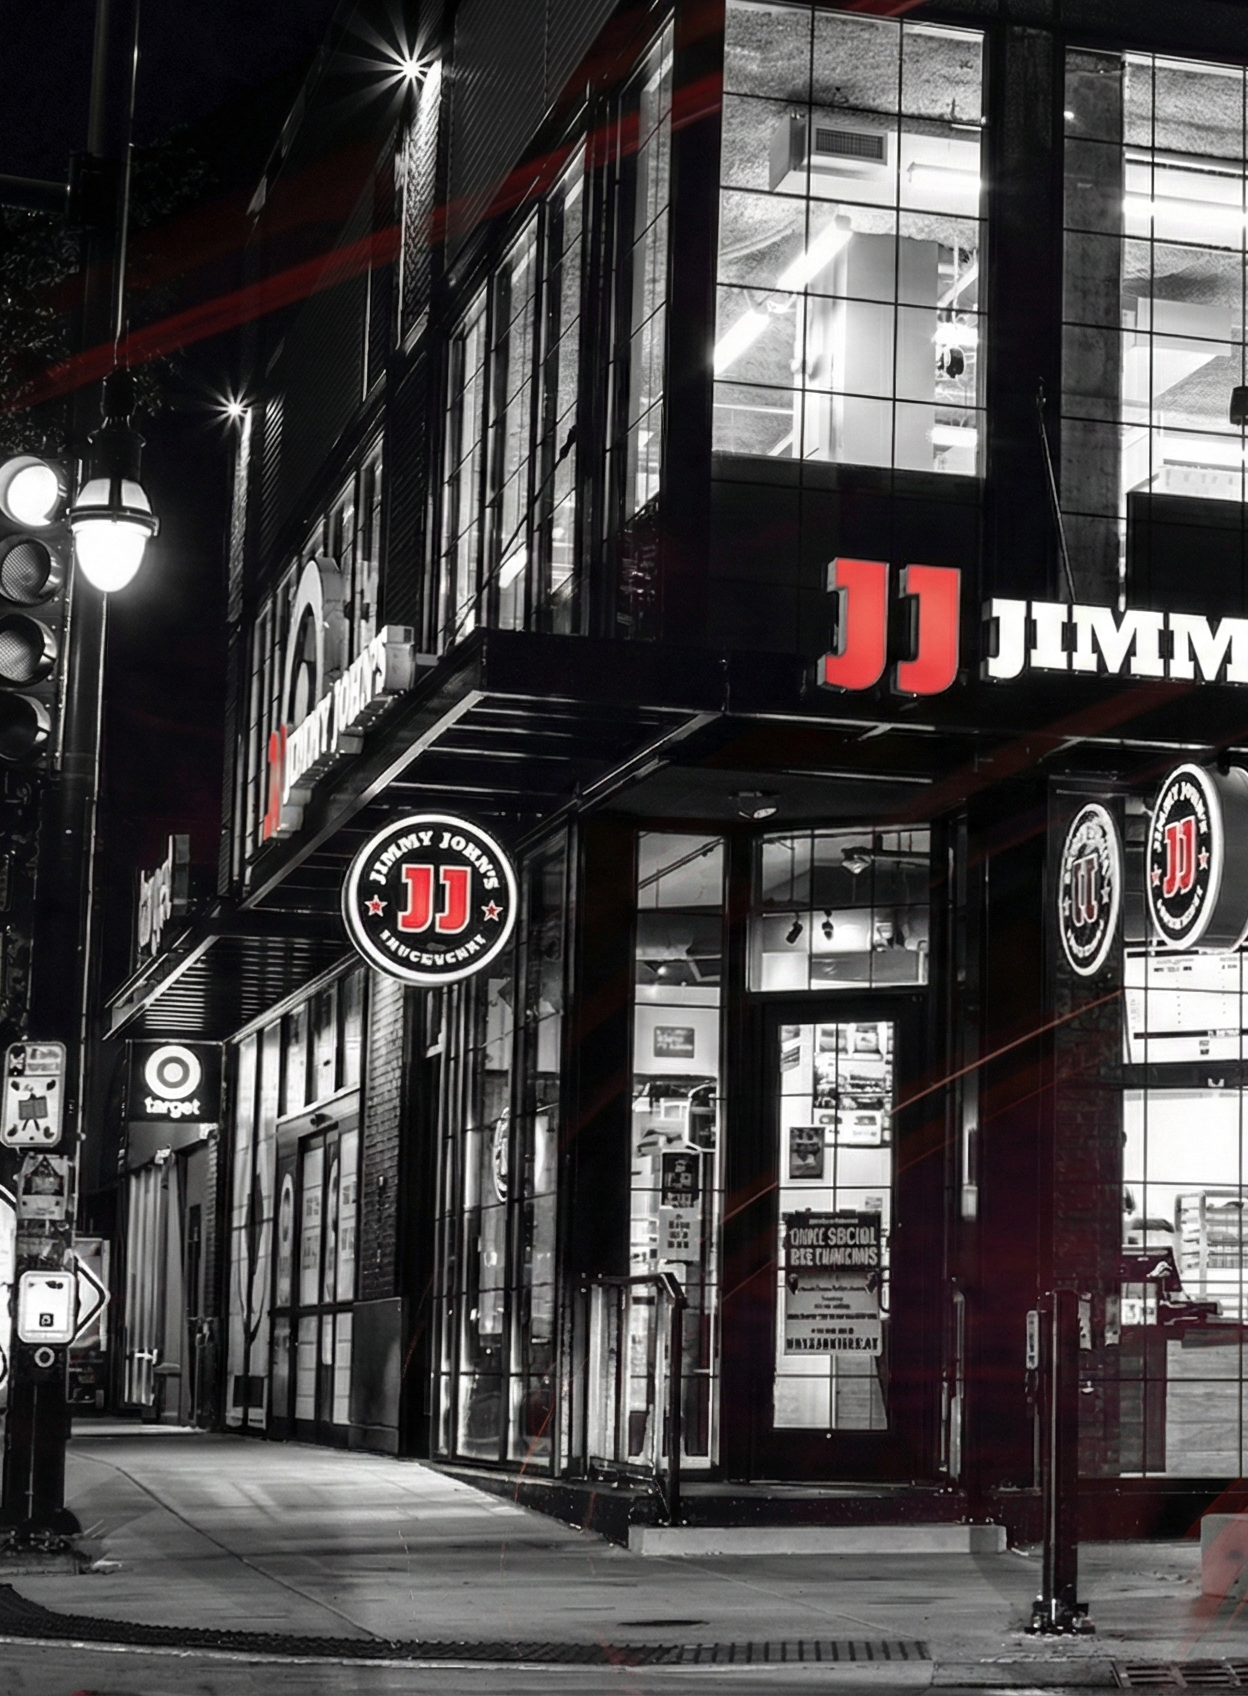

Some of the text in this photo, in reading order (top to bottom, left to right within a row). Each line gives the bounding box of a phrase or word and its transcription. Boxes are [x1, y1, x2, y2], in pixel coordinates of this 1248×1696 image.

[818, 557, 962, 697] JJ
[369, 831, 501, 891] JIMMY JOHN'S
[1163, 815, 1197, 898] JJ
[397, 863, 472, 934] JJ
[144, 1096, 201, 1119] target
